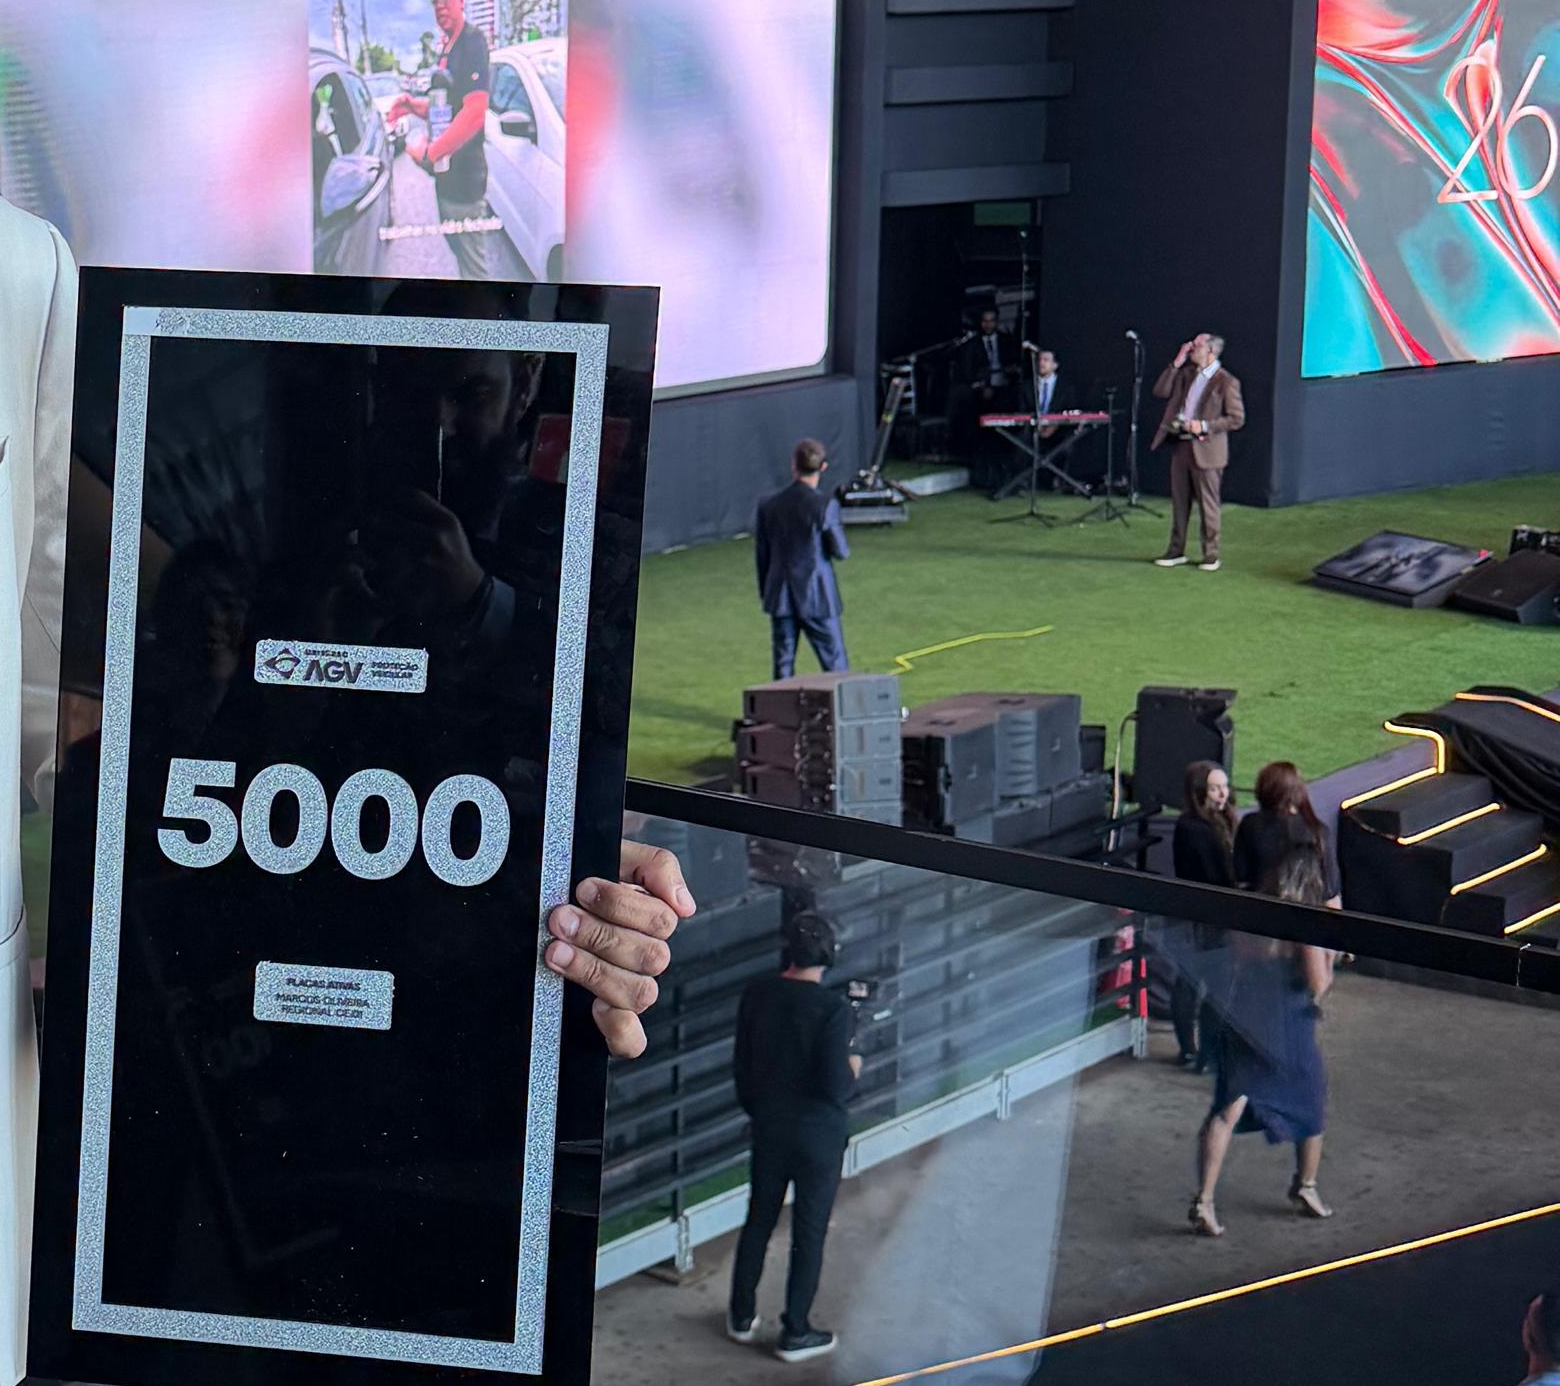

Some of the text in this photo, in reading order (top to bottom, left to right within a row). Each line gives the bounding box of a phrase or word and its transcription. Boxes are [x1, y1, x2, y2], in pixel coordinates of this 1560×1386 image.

[1438, 55, 1558, 204] 26
[303, 659, 364, 684] AGV
[157, 757, 511, 887] 5000
[286, 977, 325, 989] PLACAS
[276, 993, 370, 1008] MARCOS OLIVEIRA
[281, 1005, 333, 1017] REGIONAL
